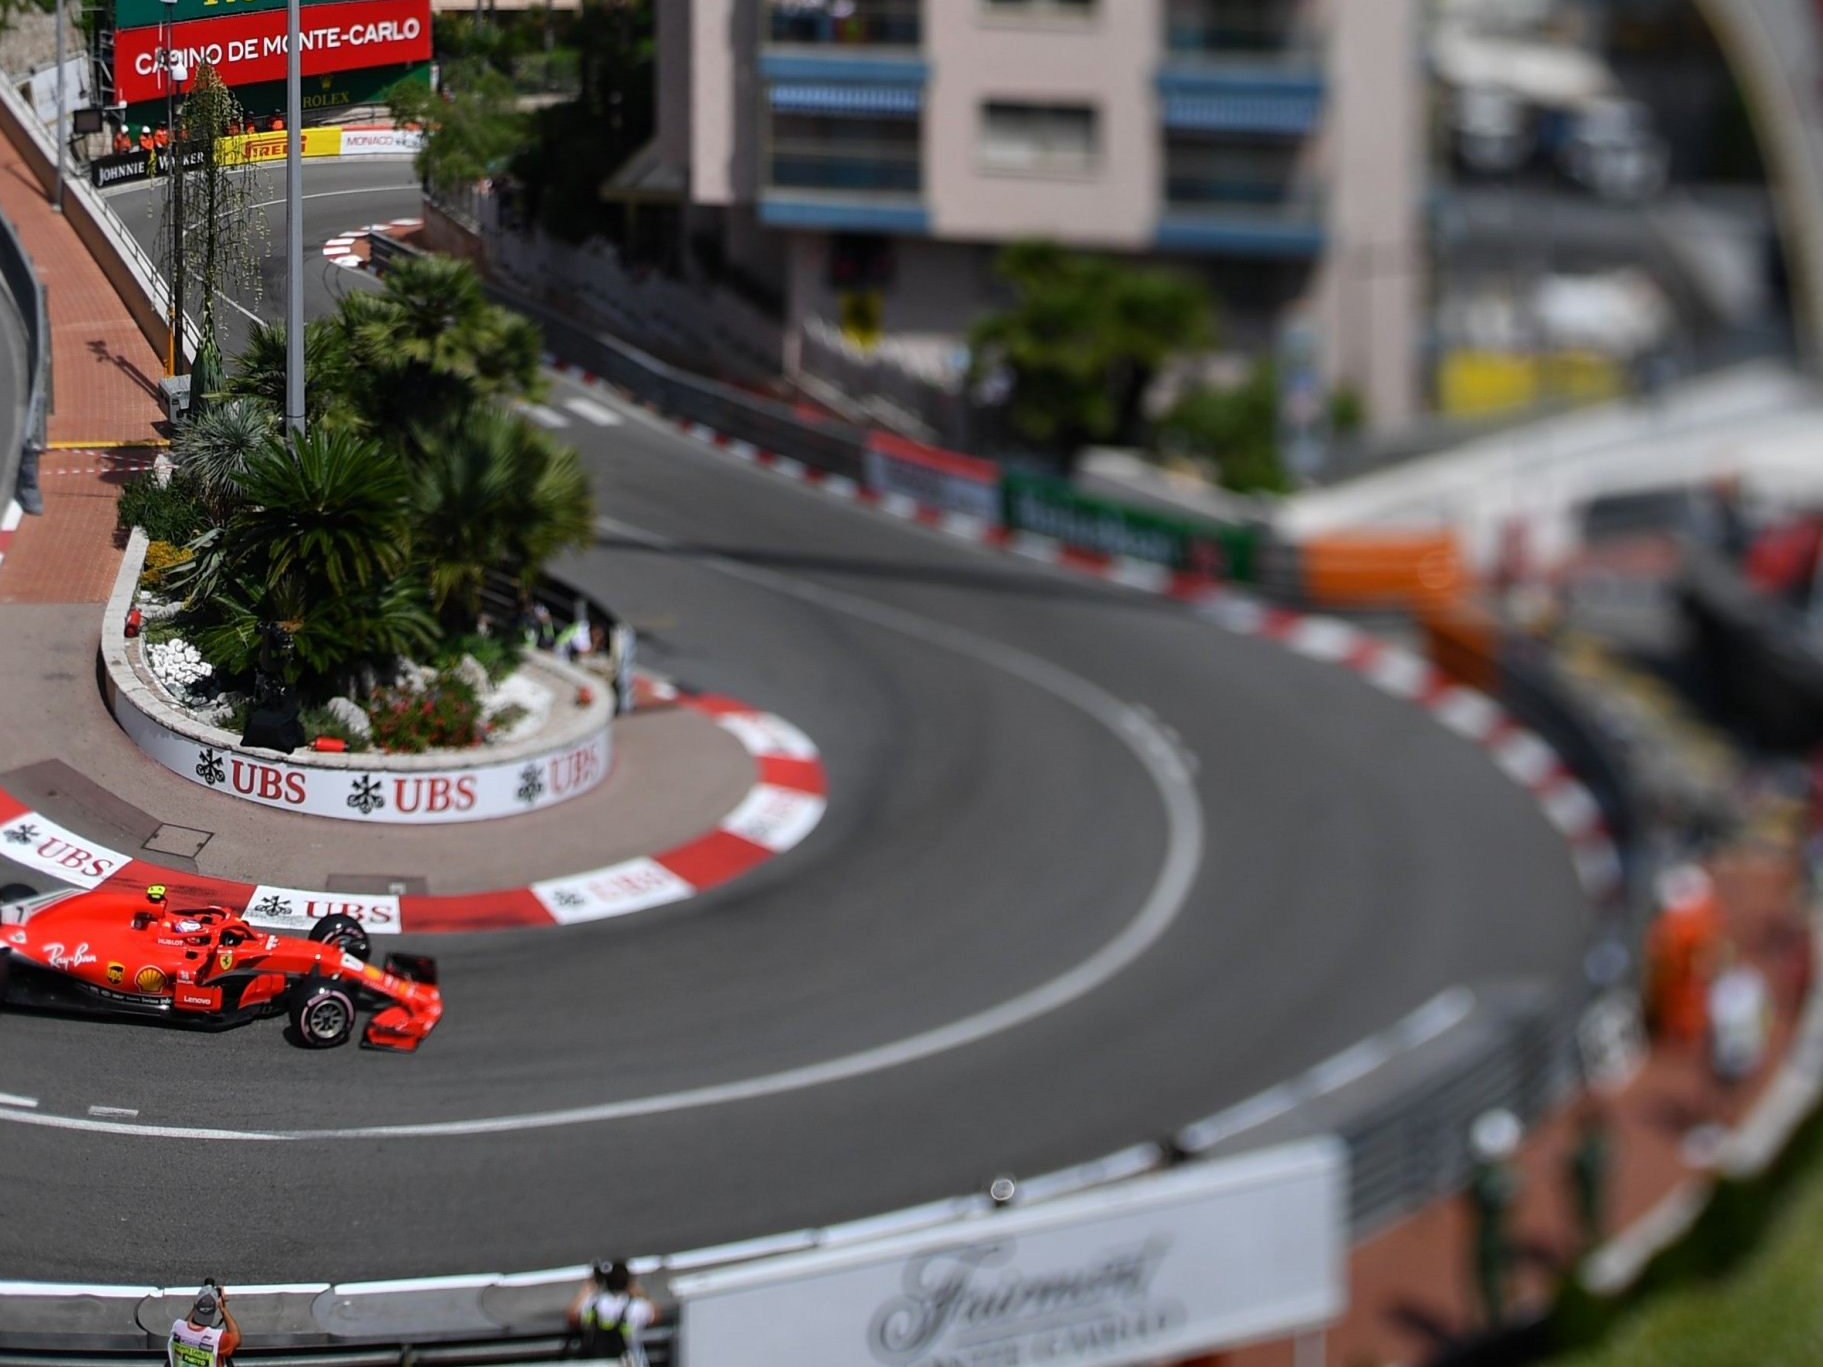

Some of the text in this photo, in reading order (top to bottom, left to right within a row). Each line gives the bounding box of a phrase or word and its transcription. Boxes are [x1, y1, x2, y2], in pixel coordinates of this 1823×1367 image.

[228, 38, 259, 62] DE
[303, 91, 350, 110] ROLEX
[347, 135, 394, 147] MONACO
[99, 152, 204, 186] JOHNNIE WKER
[548, 742, 598, 794] UBS
[231, 759, 306, 805] UBS
[393, 775, 475, 814] UBS
[36, 836, 114, 878] UBS
[304, 900, 393, 924] UBS
[158, 937, 184, 947] HUBLOT
[42, 942, 97, 970] Ray-Ban
[183, 994, 212, 1006] Lenovo
